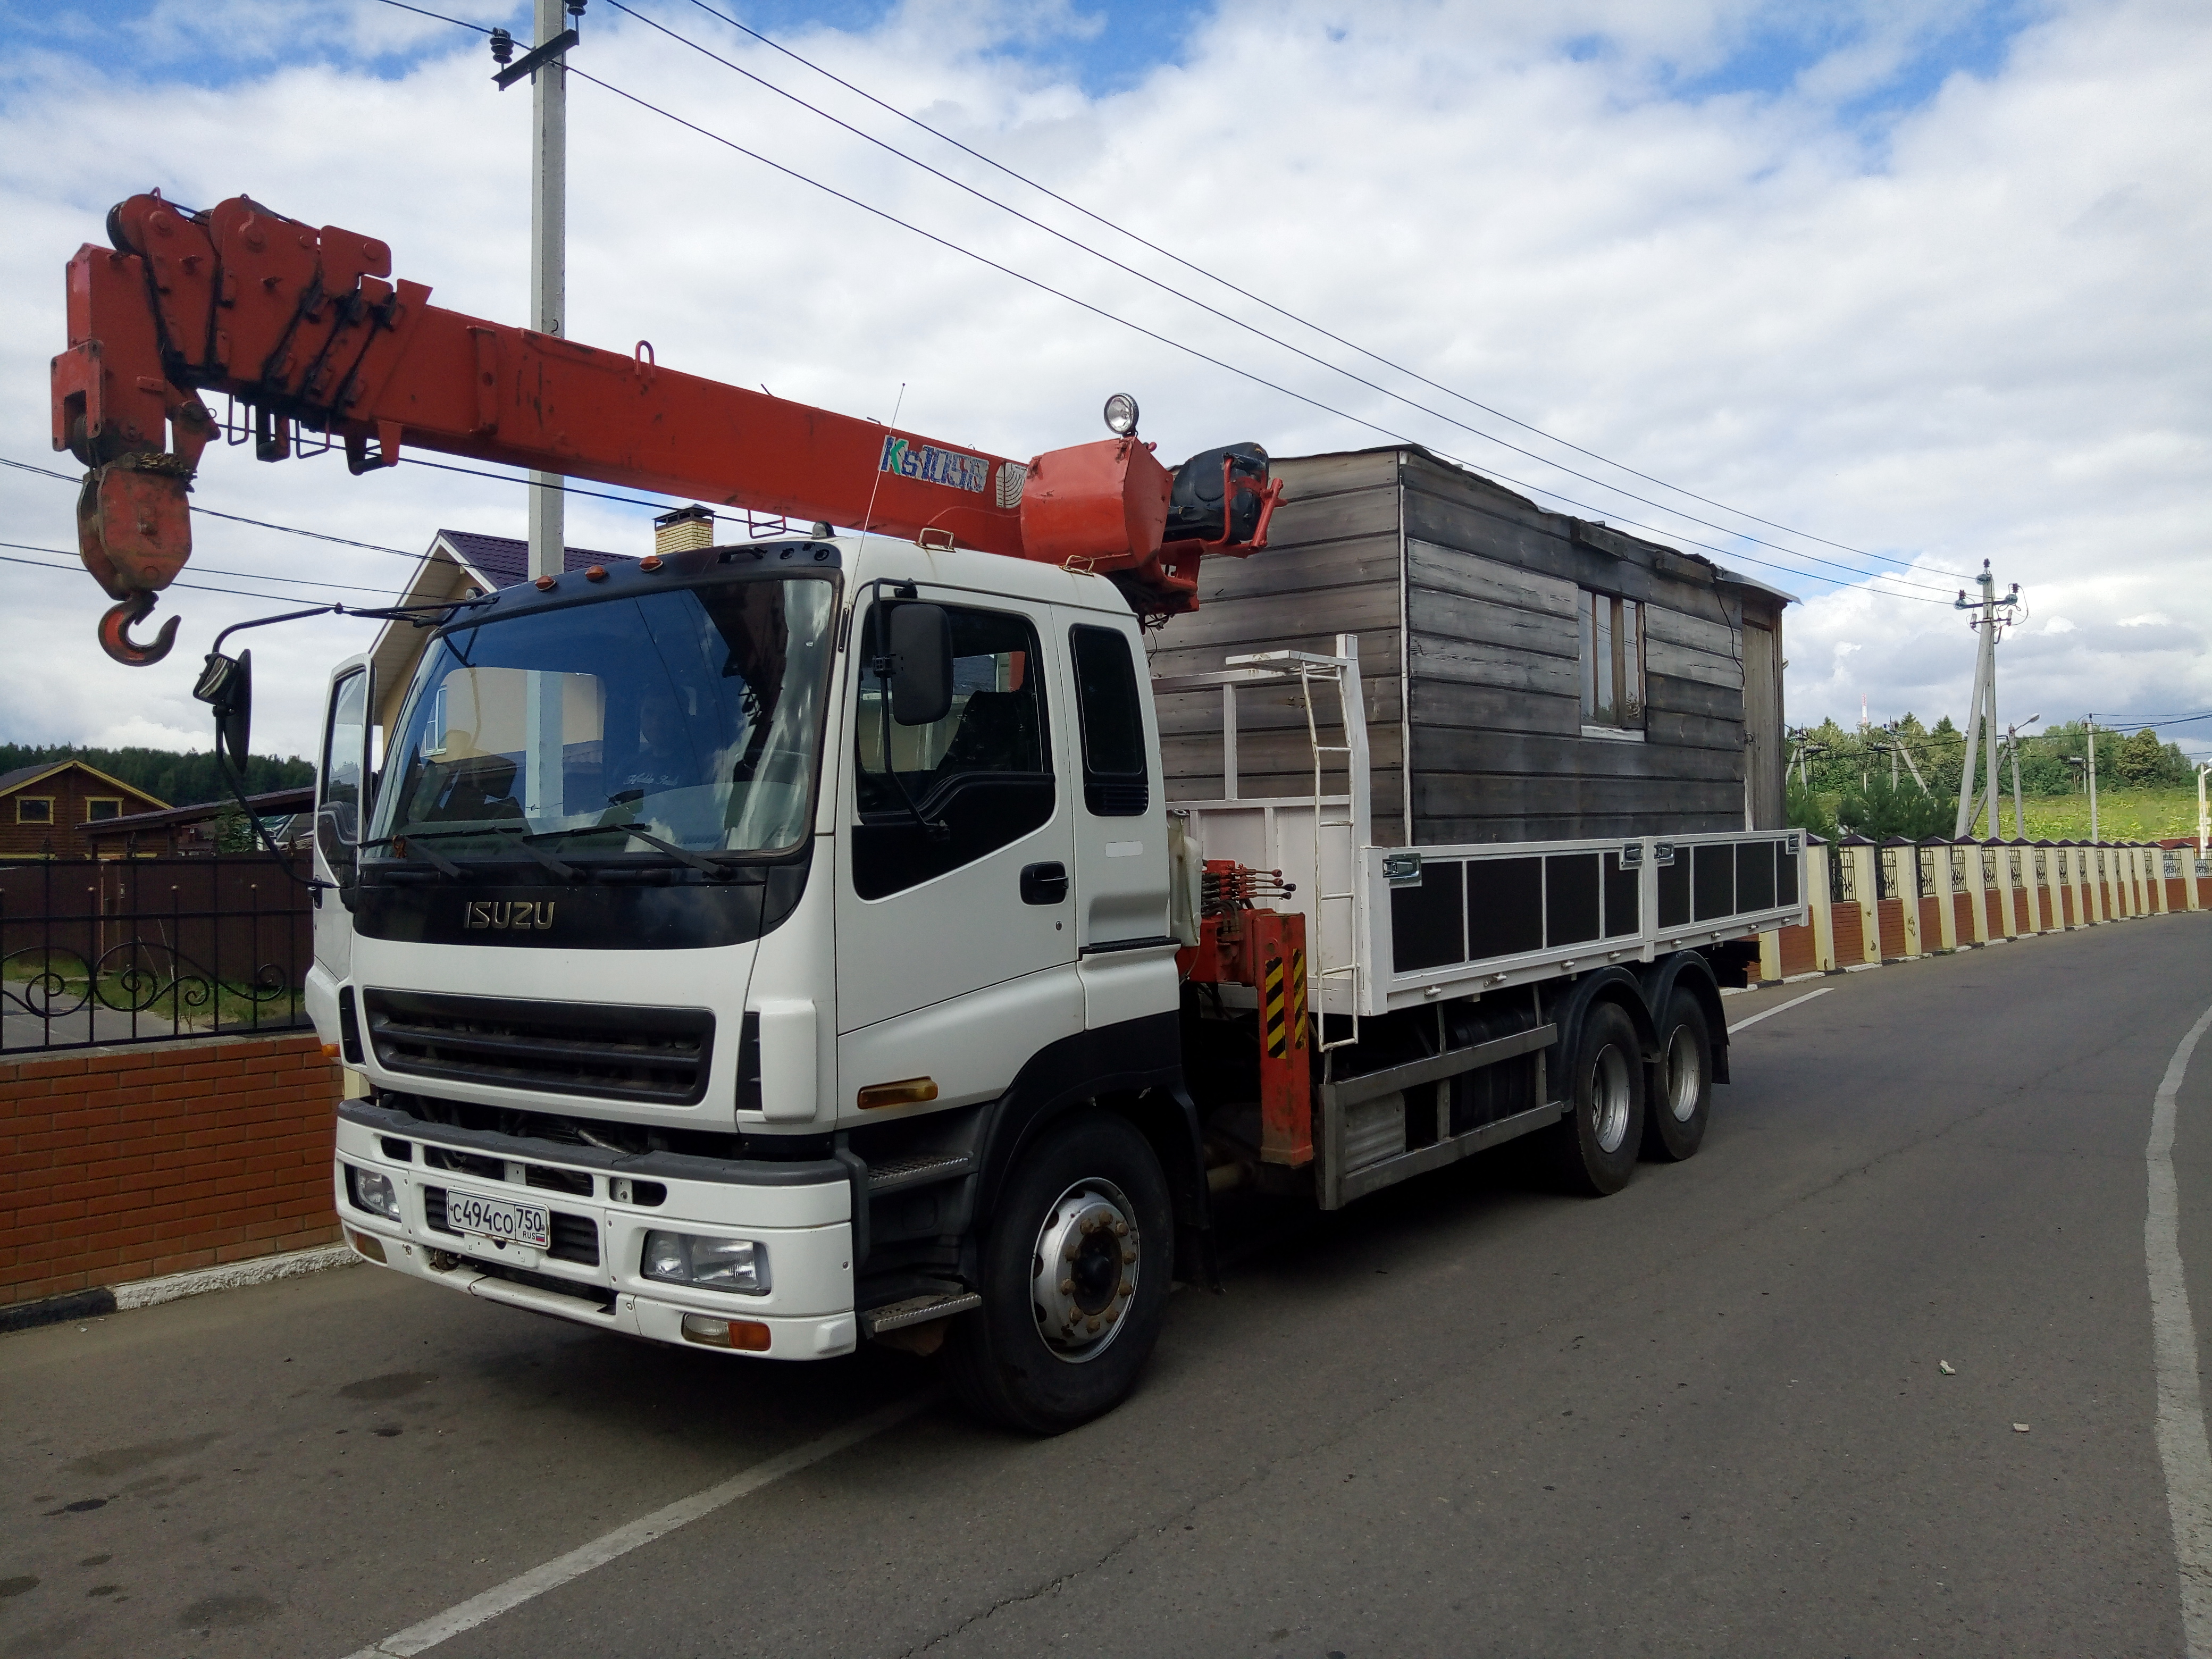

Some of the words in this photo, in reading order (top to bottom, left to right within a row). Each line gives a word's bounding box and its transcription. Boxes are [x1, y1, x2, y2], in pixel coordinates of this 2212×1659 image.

[464, 902, 555, 929] ISUZU
[453, 1200, 513, 1234] C494CO
[516, 1208, 542, 1232] 750
[523, 1231, 535, 1240] RUS
